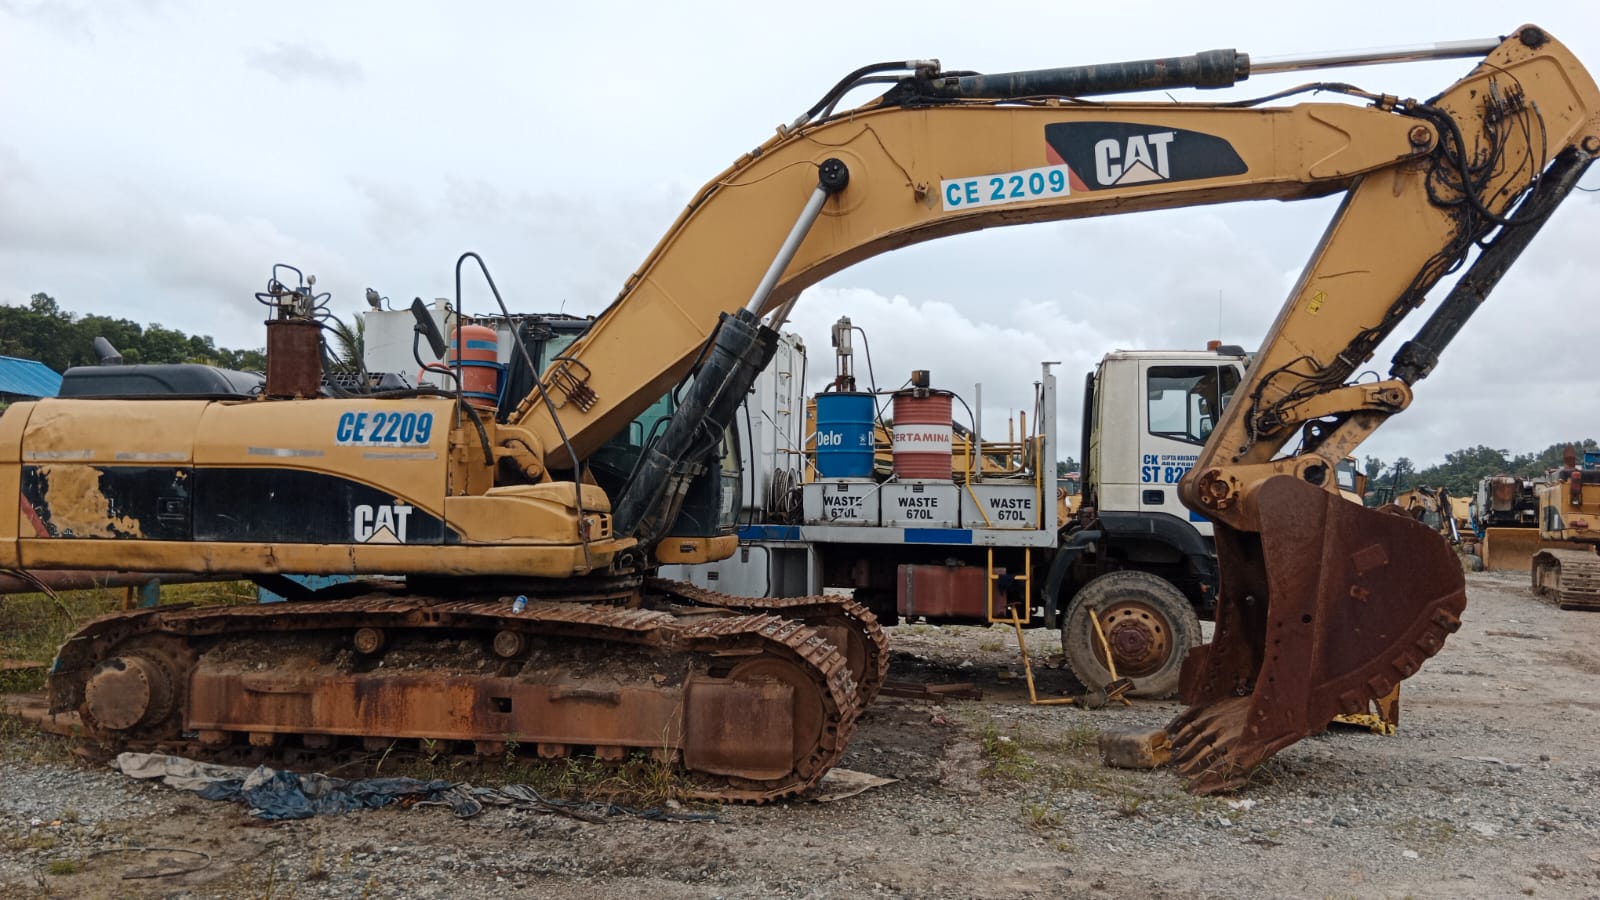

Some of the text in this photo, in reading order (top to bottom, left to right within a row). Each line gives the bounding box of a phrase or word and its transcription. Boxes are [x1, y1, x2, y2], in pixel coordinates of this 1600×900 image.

[1094, 131, 1174, 186] CAT
[945, 169, 1065, 207] CE 2209
[336, 412, 433, 443] CE 2209
[817, 430, 843, 446] Delo
[893, 432, 949, 443] ERTAMINA
[1143, 454, 1159, 465] CK
[1141, 466, 1161, 483] ST
[824, 496, 863, 506] WASTE
[898, 497, 938, 507] WASTE
[990, 498, 1031, 509] WASTE
[906, 509, 933, 519] 670L
[998, 510, 1026, 521] 670L
[353, 504, 413, 544] CAT
